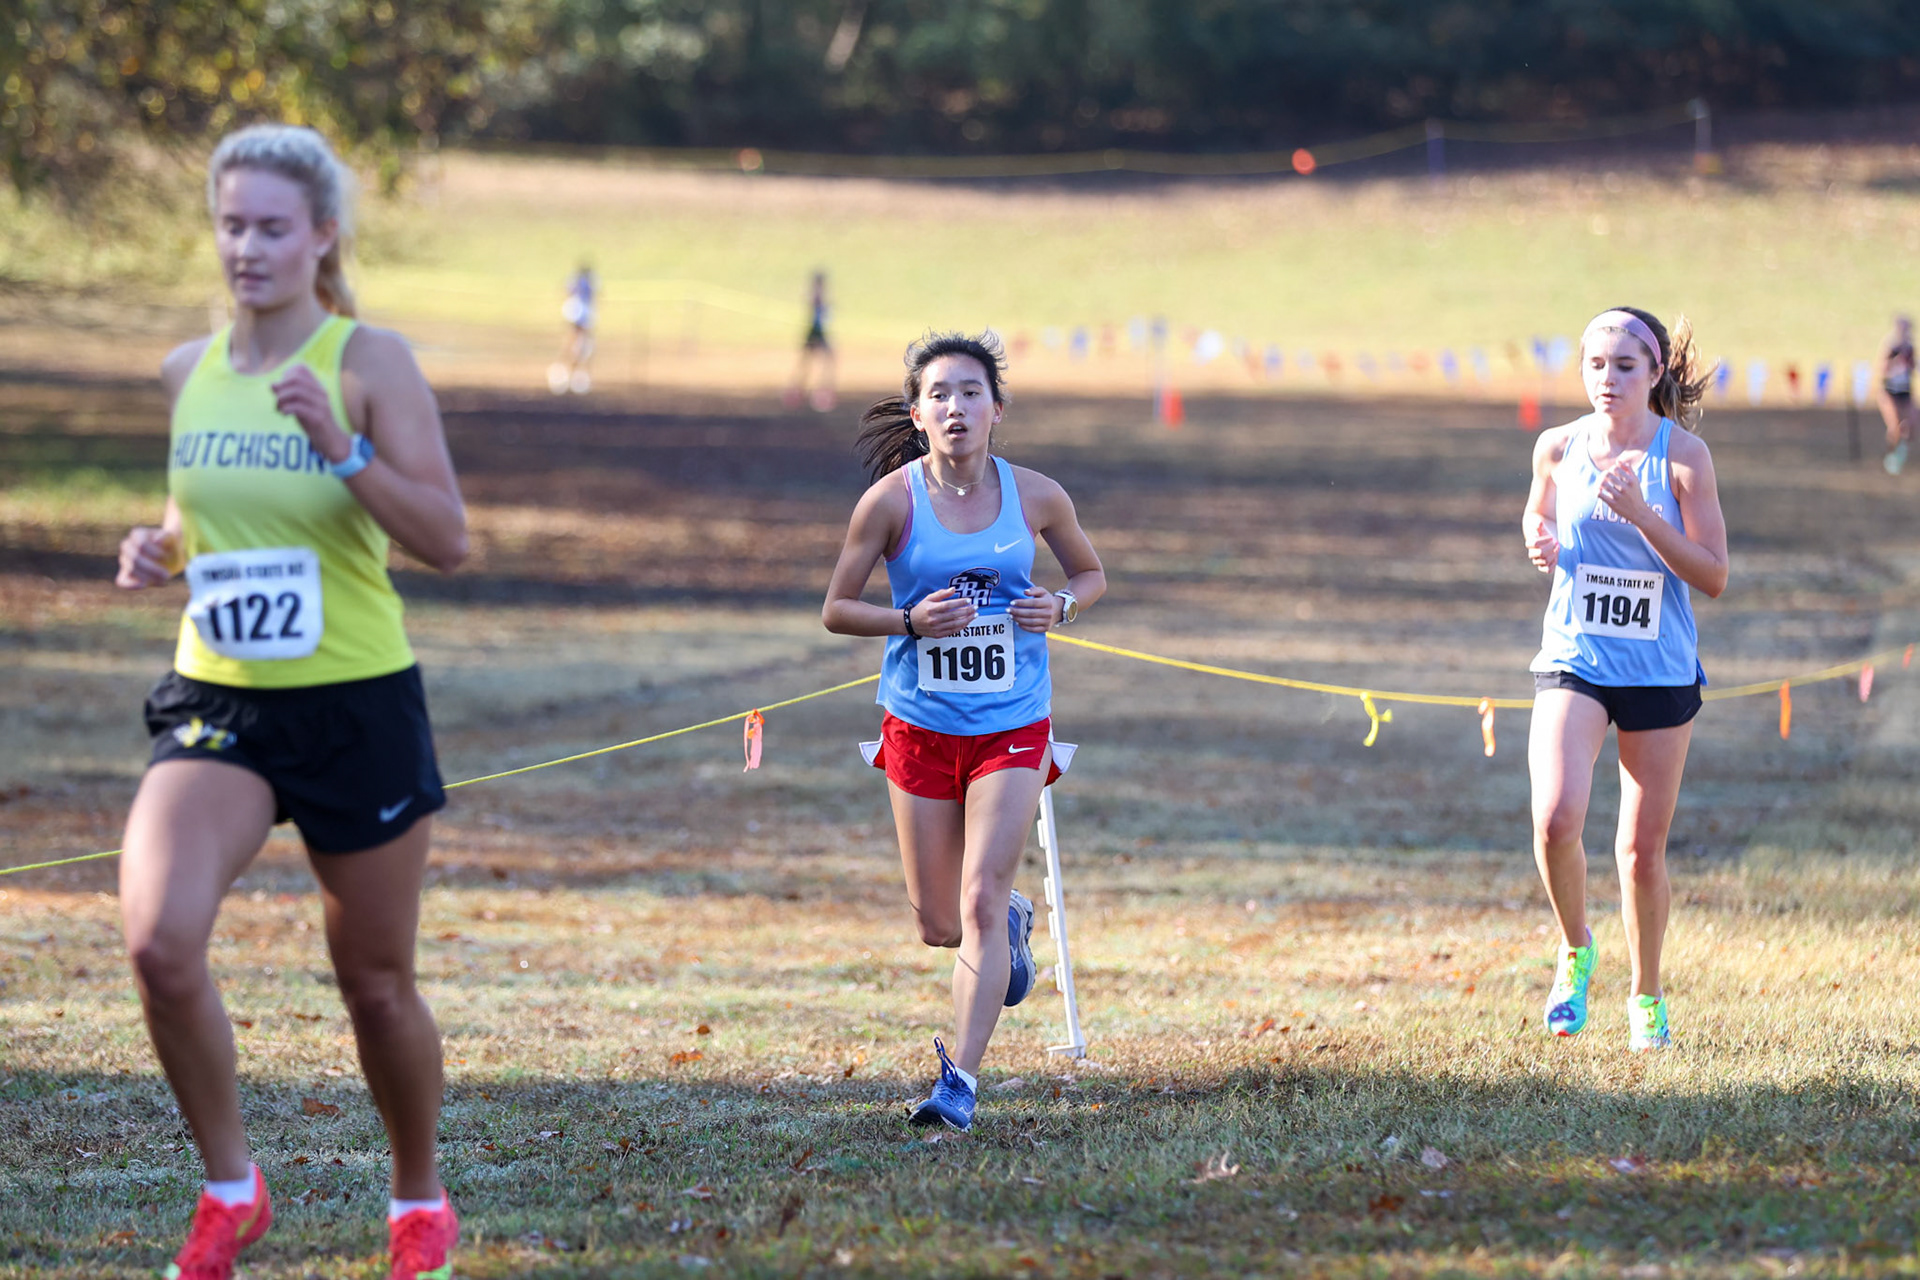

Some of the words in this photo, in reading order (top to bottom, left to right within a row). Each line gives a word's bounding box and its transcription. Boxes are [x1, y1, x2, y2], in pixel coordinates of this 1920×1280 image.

[172, 432, 326, 474] HUTCHISON
[950, 576, 990, 606] SBA
[1586, 573, 1615, 587] TMSAA
[1616, 577, 1641, 589] STATE
[1643, 579, 1655, 590] XC
[207, 591, 303, 642] 1122
[1583, 592, 1651, 628] 1194
[963, 625, 991, 637] STATE
[992, 623, 1005, 635] XC
[926, 644, 1006, 682] 1196
